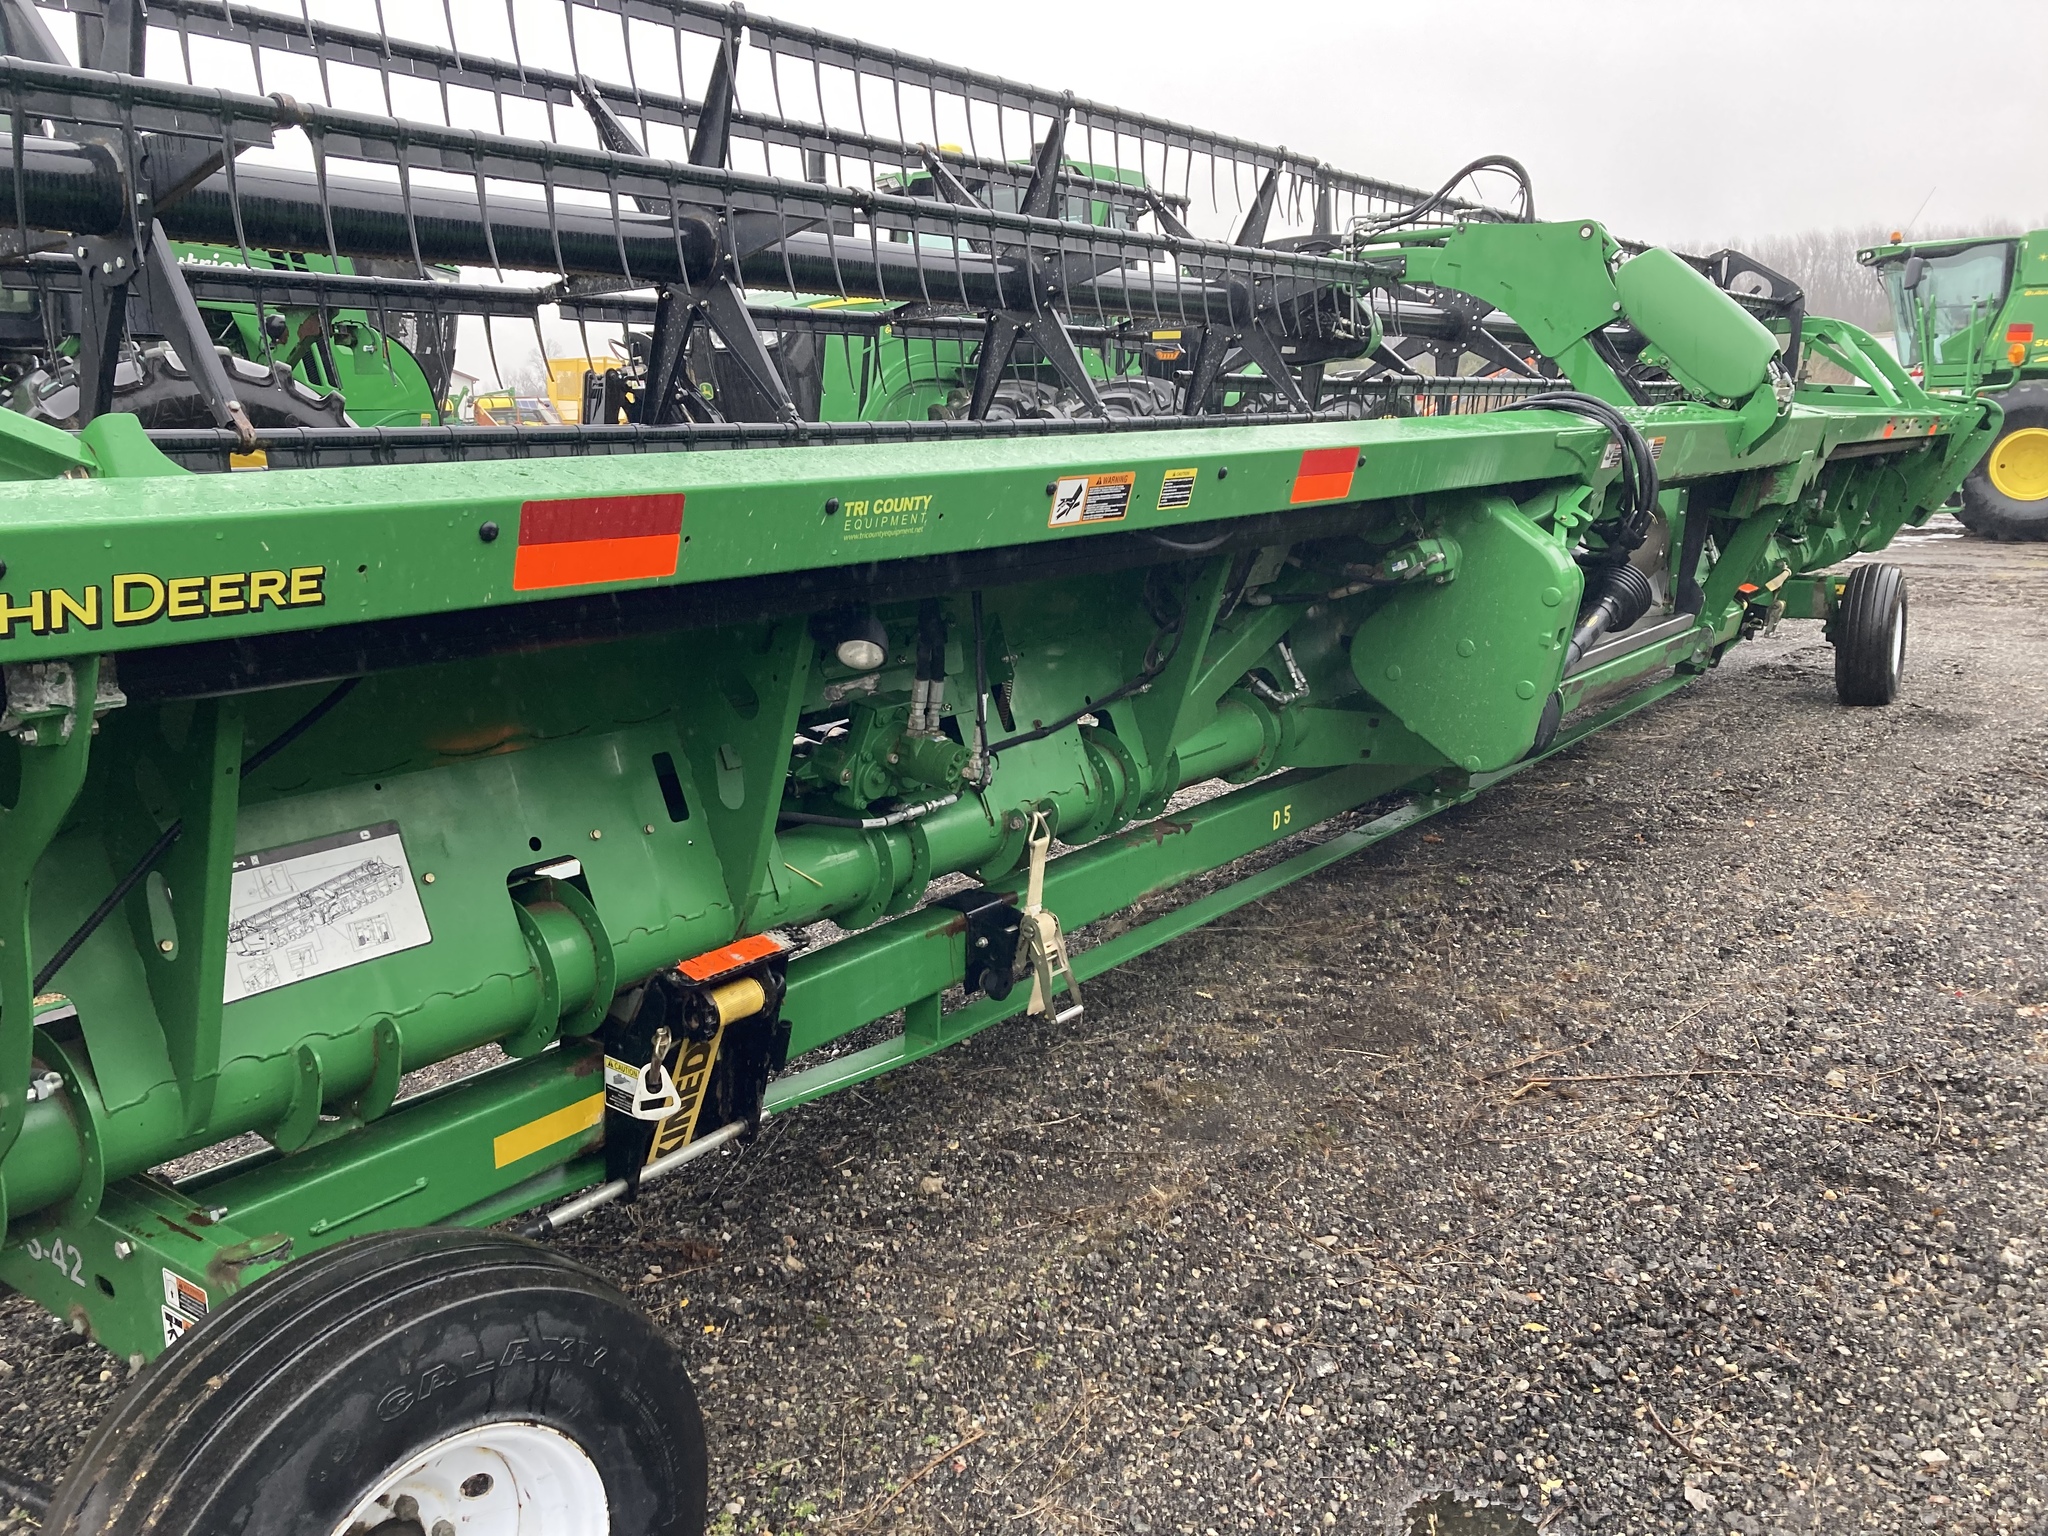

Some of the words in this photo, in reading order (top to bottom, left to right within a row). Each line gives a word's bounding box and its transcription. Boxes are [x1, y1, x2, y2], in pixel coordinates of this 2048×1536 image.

[1102, 474, 1129, 485] WARNING
[844, 501, 870, 517] TRI
[873, 494, 933, 515] COUNTY
[844, 513, 927, 531] EQUIPMENT
[843, 526, 924, 541] www.tricountyequipment.net
[112, 565, 325, 626] DEERE
[613, 1060, 639, 1078] CAUTION
[376, 1336, 608, 1422] GALAXY
